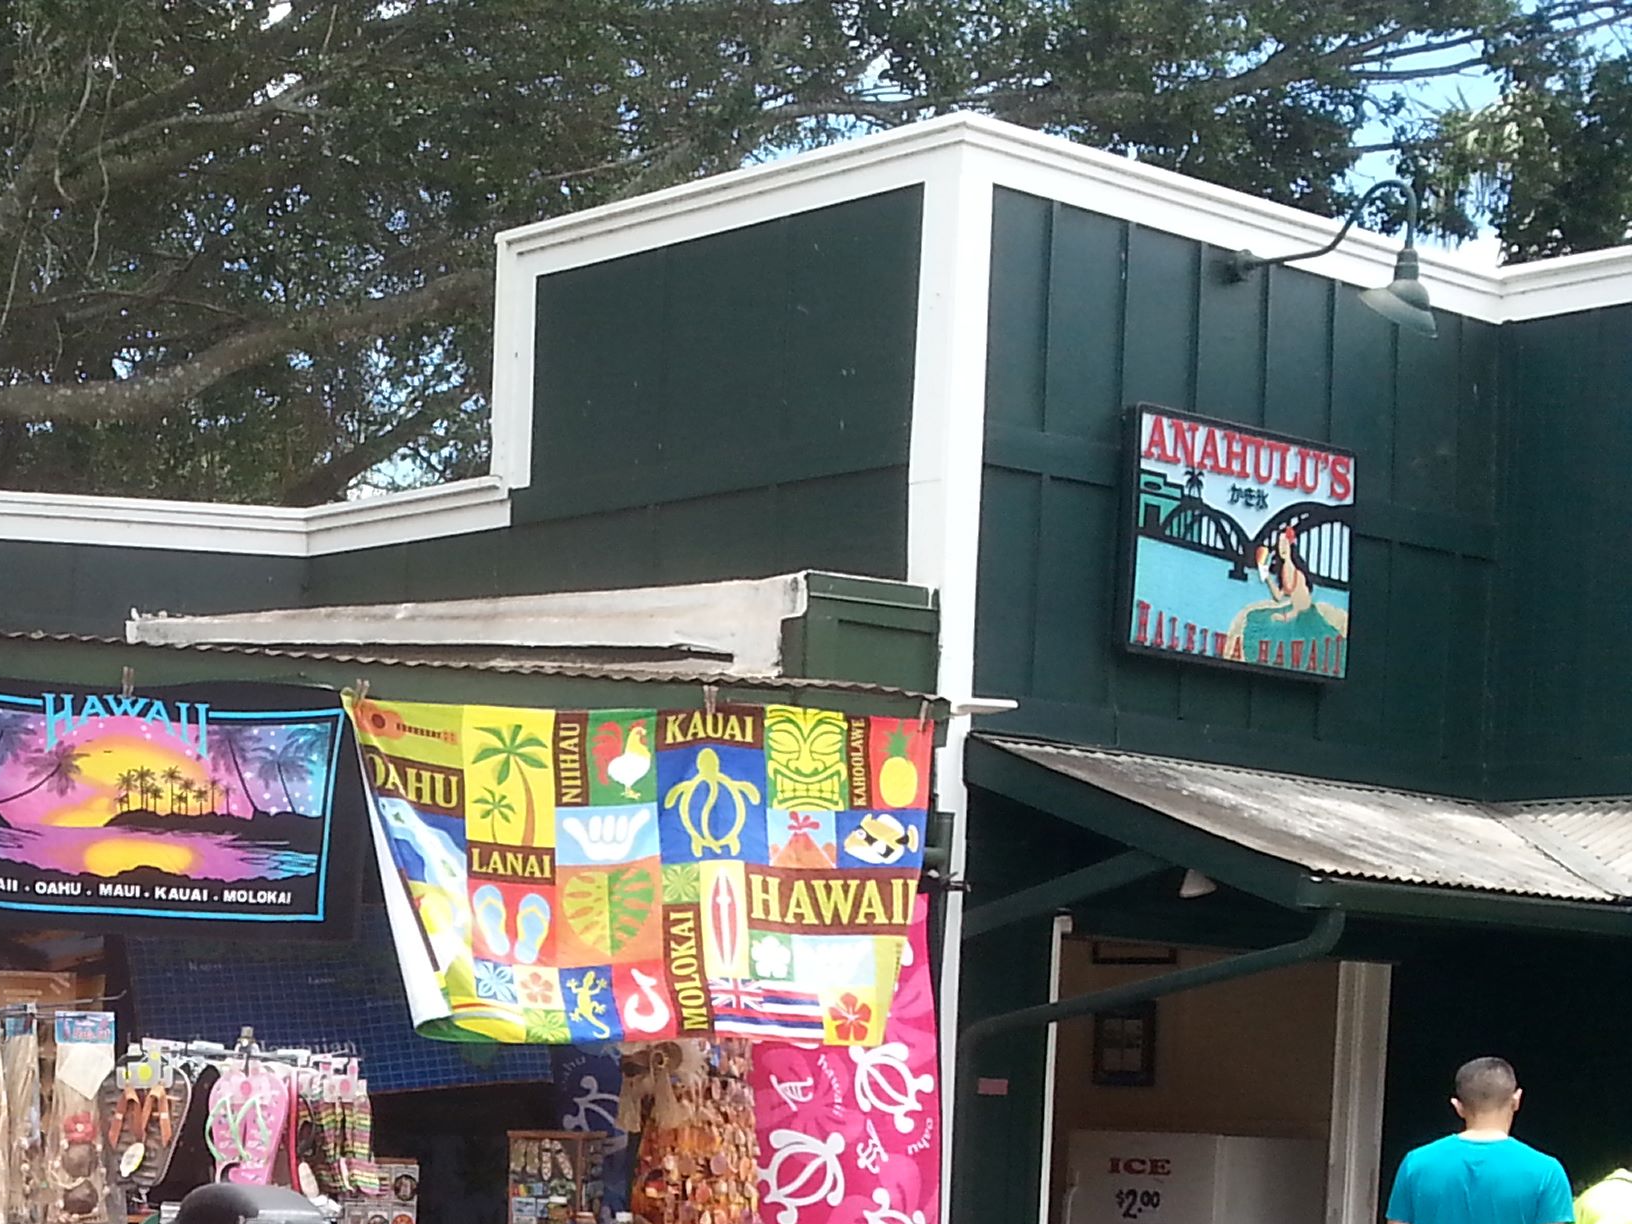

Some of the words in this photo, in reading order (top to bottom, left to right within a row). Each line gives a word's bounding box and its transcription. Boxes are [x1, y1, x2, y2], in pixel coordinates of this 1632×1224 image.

[1143, 414, 1352, 501] ANAHULU'S
[1135, 600, 1243, 661] HALEIWA
[1258, 634, 1345, 676] HAWAII
[42, 692, 210, 760] HAWAII
[665, 710, 754, 744] KAUAI
[559, 722, 582, 803] NIIHAU
[850, 718, 867, 807] KAHOOLAWE
[35, 881, 82, 896] OAHU
[98, 883, 141, 898] MAUI
[154, 886, 208, 902] KAUAI
[222, 888, 292, 905] MOLOKAI
[471, 847, 552, 878] LANAI
[749, 873, 918, 925] HAWAII
[670, 911, 709, 1030] MOLOKAI
[817, 1054, 843, 1118] hawaii
[1109, 1158, 1171, 1175] ICE
[1116, 1189, 1160, 1219] $2.00
